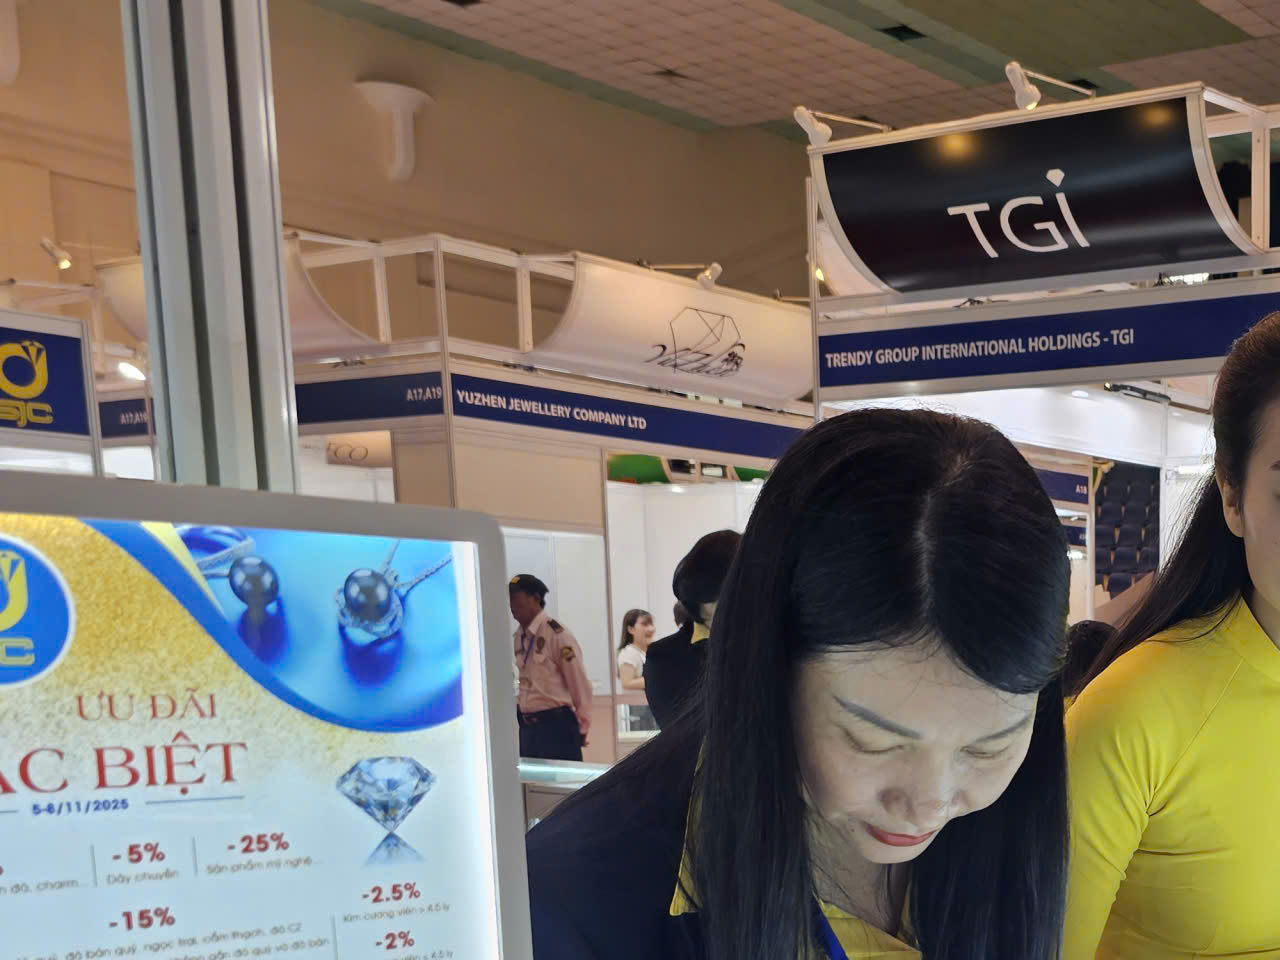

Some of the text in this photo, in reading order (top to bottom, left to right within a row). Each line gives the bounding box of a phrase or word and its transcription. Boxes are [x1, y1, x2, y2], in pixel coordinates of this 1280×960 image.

[825, 350, 873, 369] TRENDY
[875, 348, 920, 365] GROUP
[921, 340, 1026, 361] INTERNATIONAL
[1027, 331, 1101, 351] HOLDINGS
[1110, 328, 1135, 345] TGI
[406, 386, 443, 402] A17,A19
[456, 389, 647, 430] YUZHEN JEWELLERY COMPANY LTD
[92, 729, 248, 795] BIỆT
